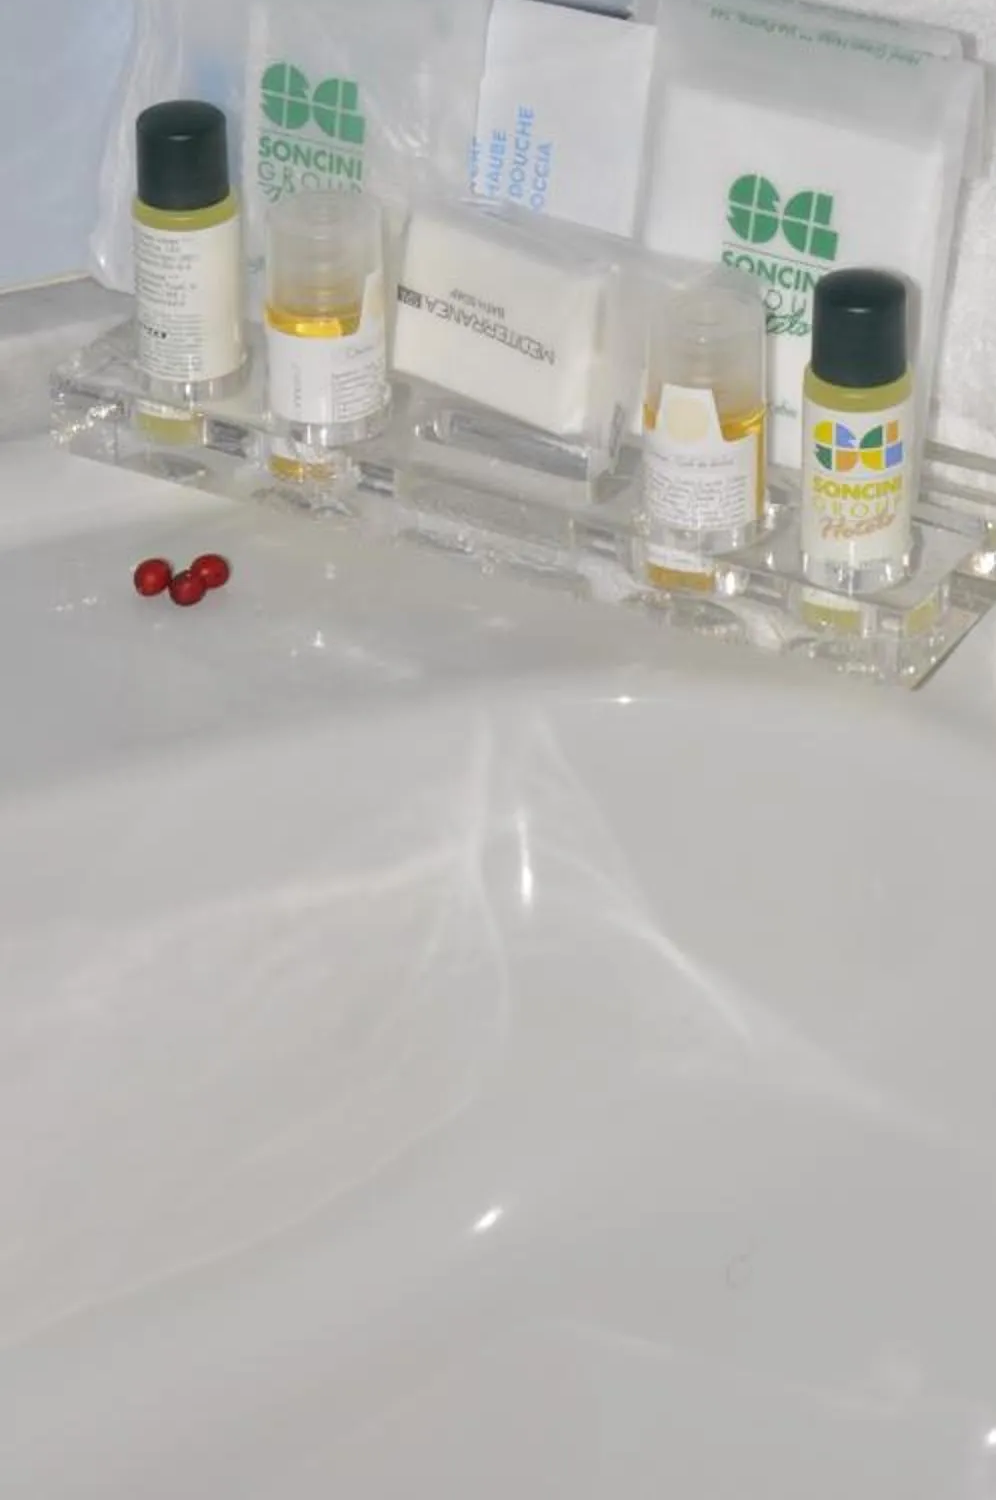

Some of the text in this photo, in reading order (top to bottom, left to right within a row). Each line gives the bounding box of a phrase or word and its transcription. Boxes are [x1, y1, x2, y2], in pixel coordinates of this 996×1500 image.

[258, 135, 363, 181] SONCINI
[509, 104, 535, 198] DOUCHE
[531, 142, 553, 211] OCCIA
[722, 250, 815, 292] SONCIN
